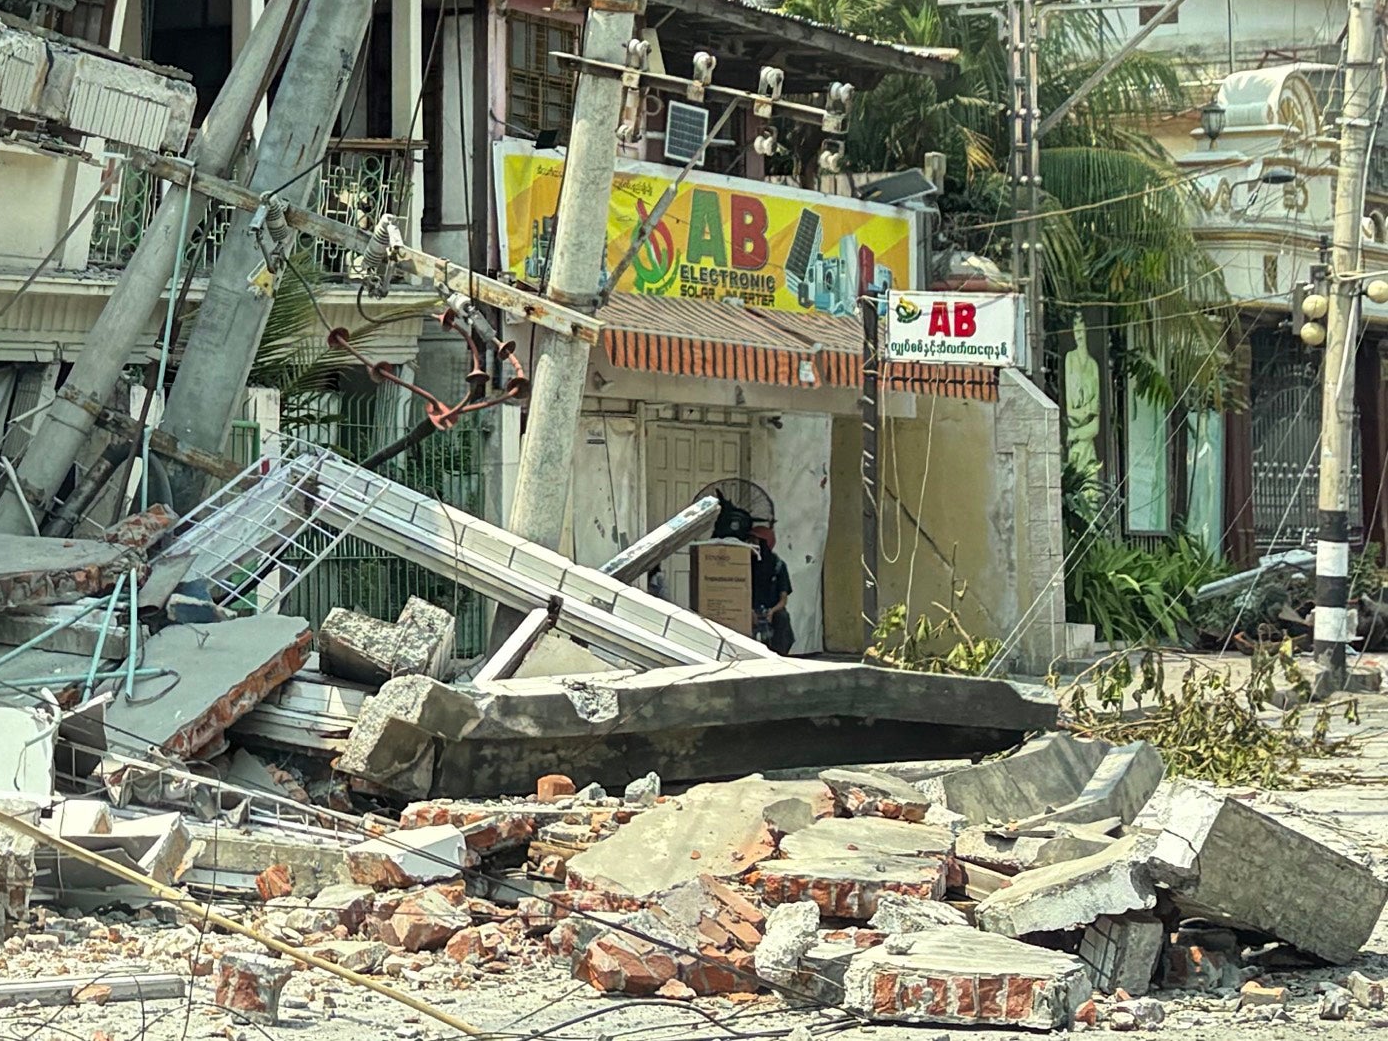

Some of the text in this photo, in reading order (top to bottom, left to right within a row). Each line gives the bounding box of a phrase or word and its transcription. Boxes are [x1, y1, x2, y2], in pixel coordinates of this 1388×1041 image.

[686, 188, 769, 271] AB
[680, 264, 776, 294] ELECTRONIC
[680, 284, 716, 300] SOLAR
[928, 302, 977, 338] AB
